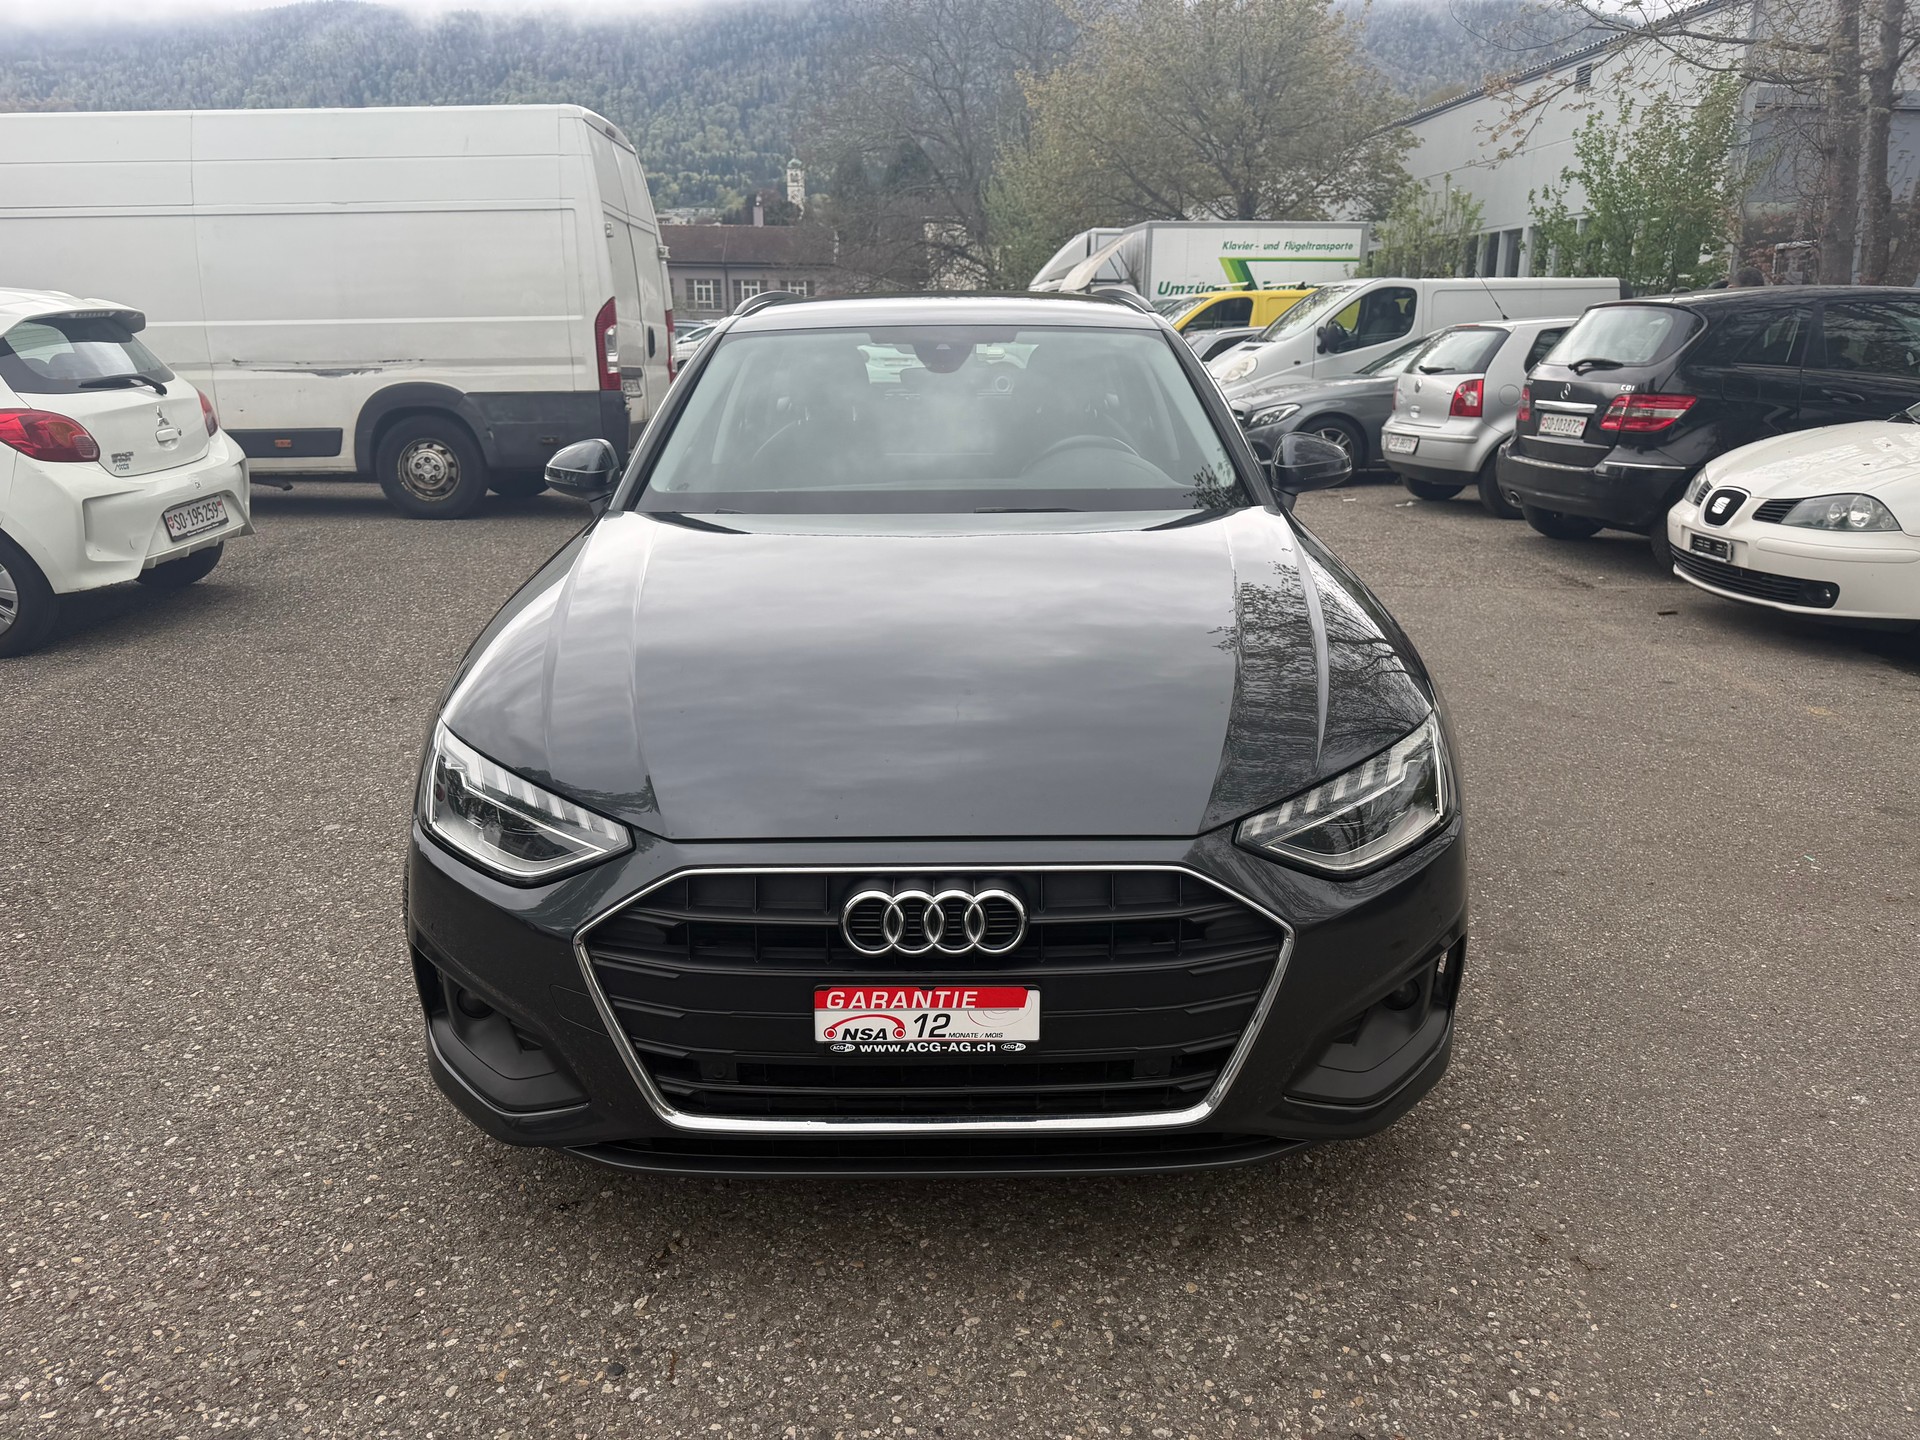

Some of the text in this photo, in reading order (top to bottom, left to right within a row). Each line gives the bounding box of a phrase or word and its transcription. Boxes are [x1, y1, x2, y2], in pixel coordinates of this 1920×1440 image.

[1222, 241, 1354, 253] Klavier- und Flügeltransporte
[1620, 384, 1636, 392] CDI
[826, 991, 978, 1009] GARANTIE
[913, 1013, 952, 1039] 12
[841, 1028, 888, 1041] NSA
[859, 1042, 996, 1052] www.ACG-AG.ch
